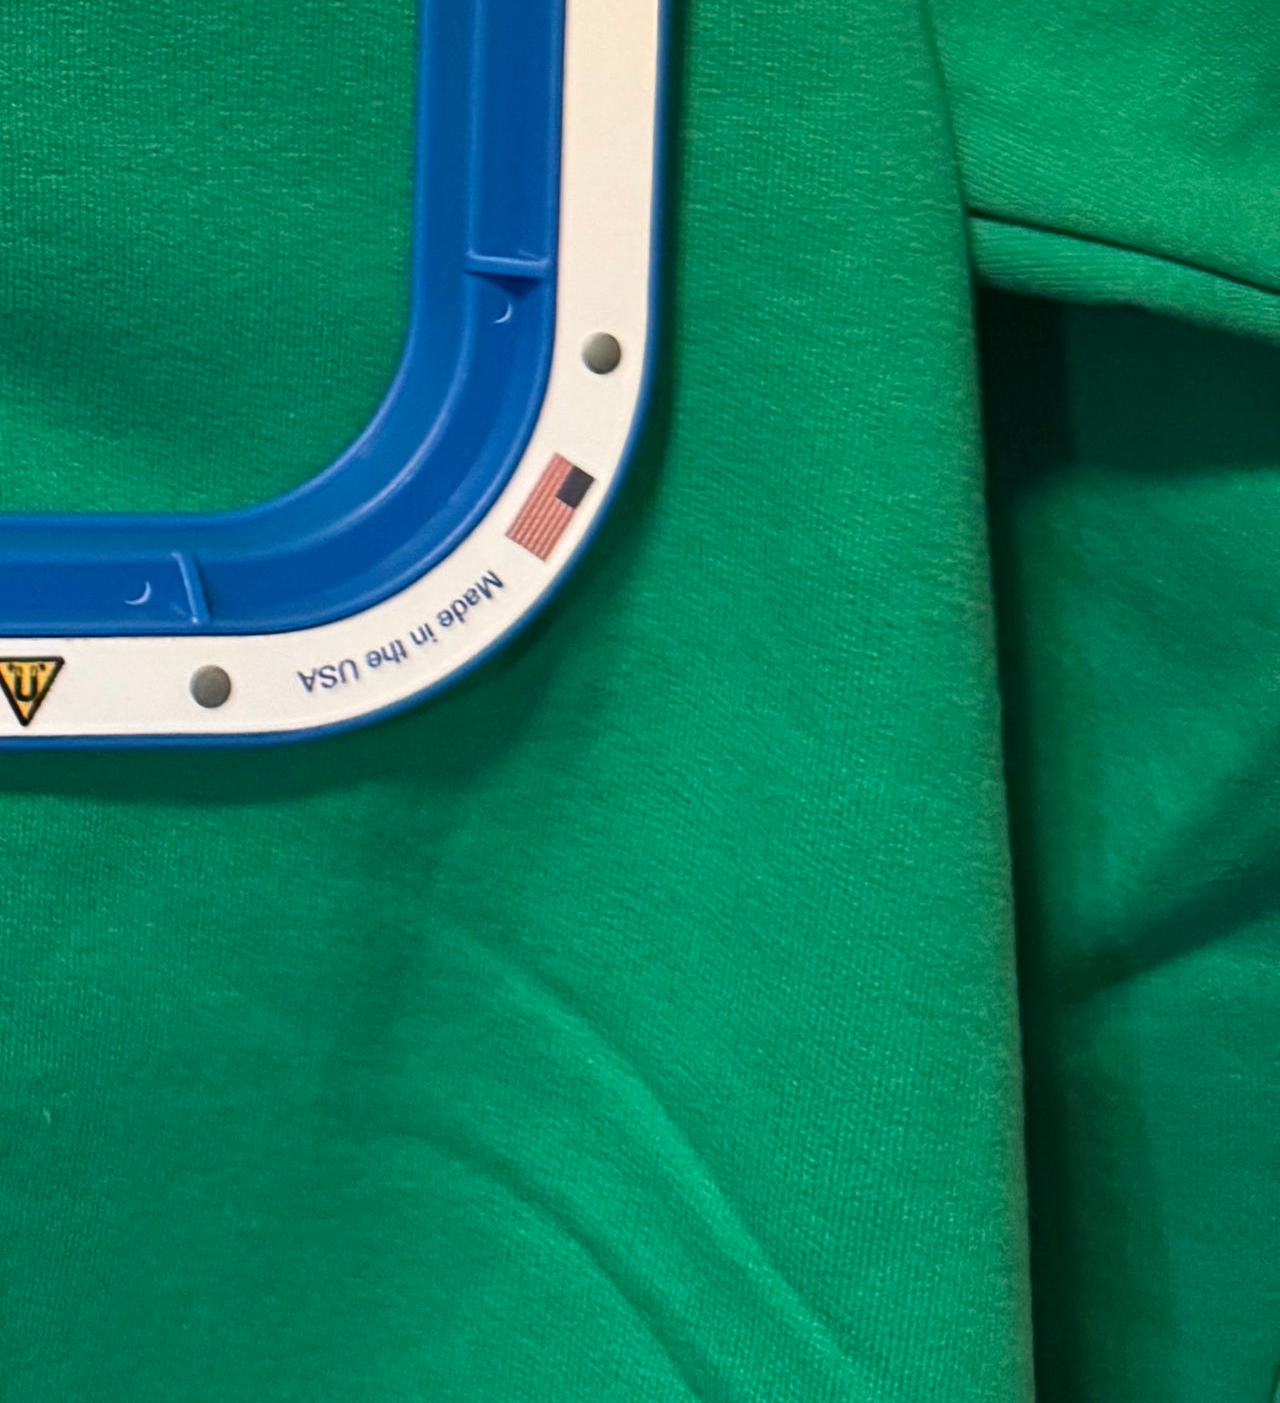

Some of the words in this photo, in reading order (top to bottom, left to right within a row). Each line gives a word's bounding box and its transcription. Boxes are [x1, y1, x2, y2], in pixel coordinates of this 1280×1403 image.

[437, 571, 504, 627] Made
[409, 623, 436, 647] in
[367, 639, 408, 669] the
[297, 659, 360, 693] USA
